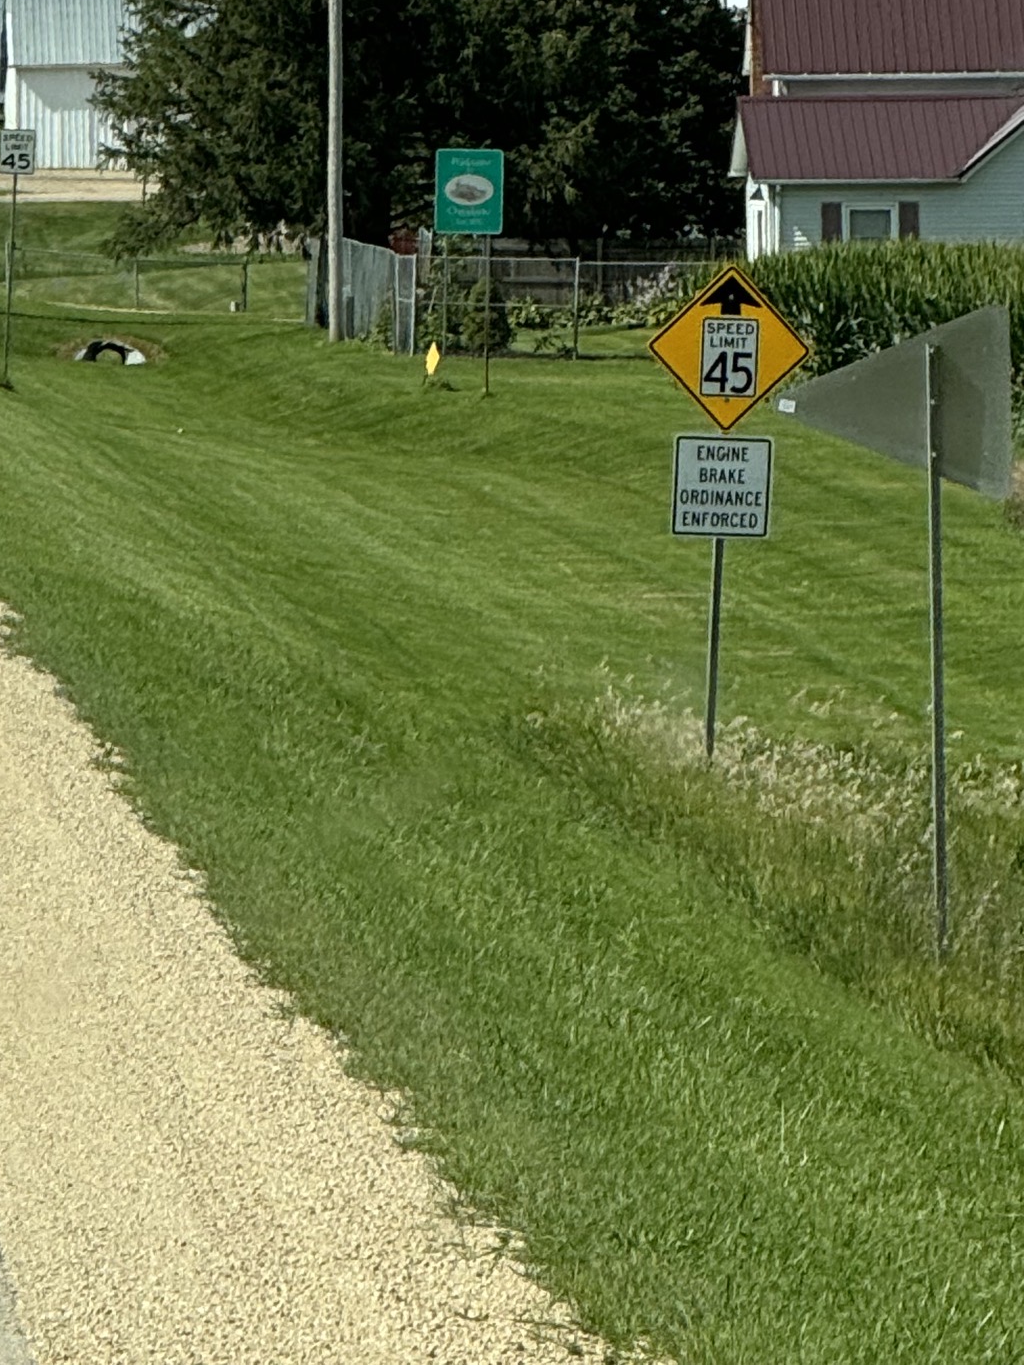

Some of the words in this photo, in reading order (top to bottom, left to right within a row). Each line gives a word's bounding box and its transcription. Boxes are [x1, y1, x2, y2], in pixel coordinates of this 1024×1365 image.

[1, 153, 31, 170] 45
[707, 322, 755, 335] SPEED
[710, 336, 747, 349] LIMIT
[704, 350, 753, 394] 45
[697, 445, 749, 462] ENGINE
[699, 467, 745, 485] BRAKE
[680, 489, 762, 507] ORDINANCE
[682, 511, 758, 528] ENFORCED
